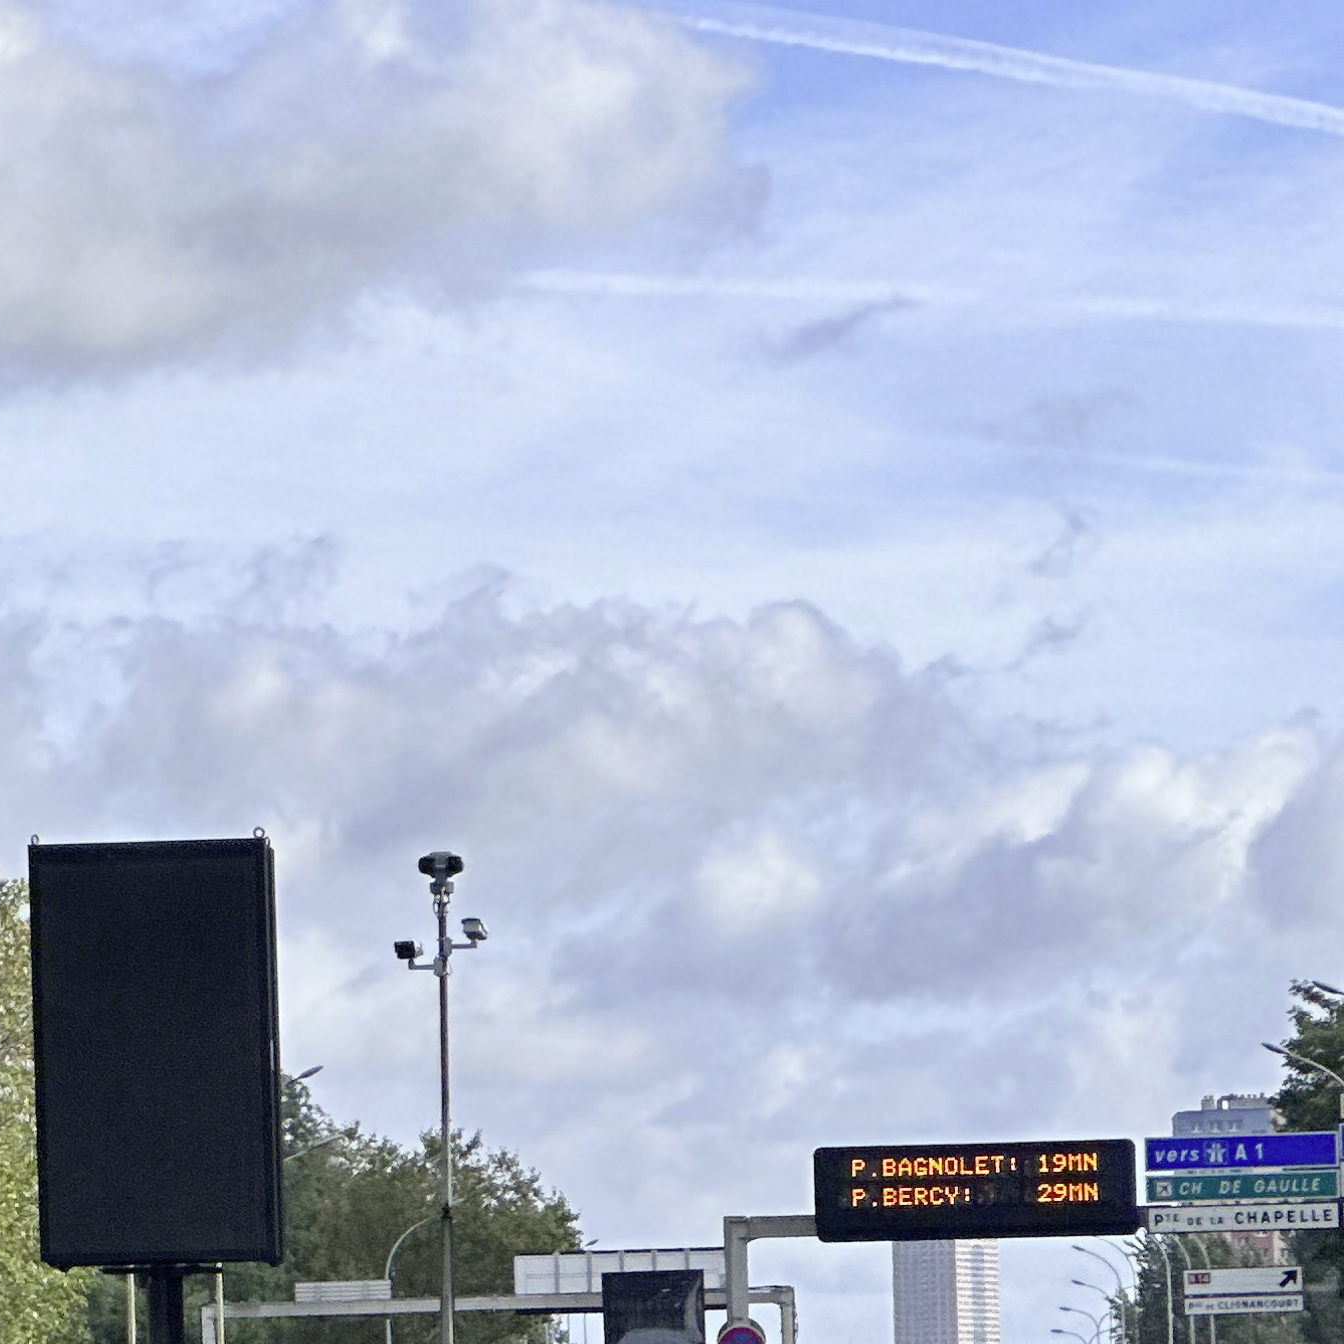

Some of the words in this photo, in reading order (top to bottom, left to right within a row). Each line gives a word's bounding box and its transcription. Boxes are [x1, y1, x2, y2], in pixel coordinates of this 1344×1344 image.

[1154, 1148, 1199, 1162] vers
[1234, 1143, 1248, 1161] A
[1255, 1142, 1264, 1160] 1
[1038, 1152, 1099, 1173] 19MN
[1037, 1183, 1100, 1203] 29MN
[1179, 1182, 1202, 1195] CH
[1219, 1180, 1242, 1194] DE
[1253, 1178, 1321, 1193] GAULLE
[1234, 1209, 1333, 1225] CHAPELLE
